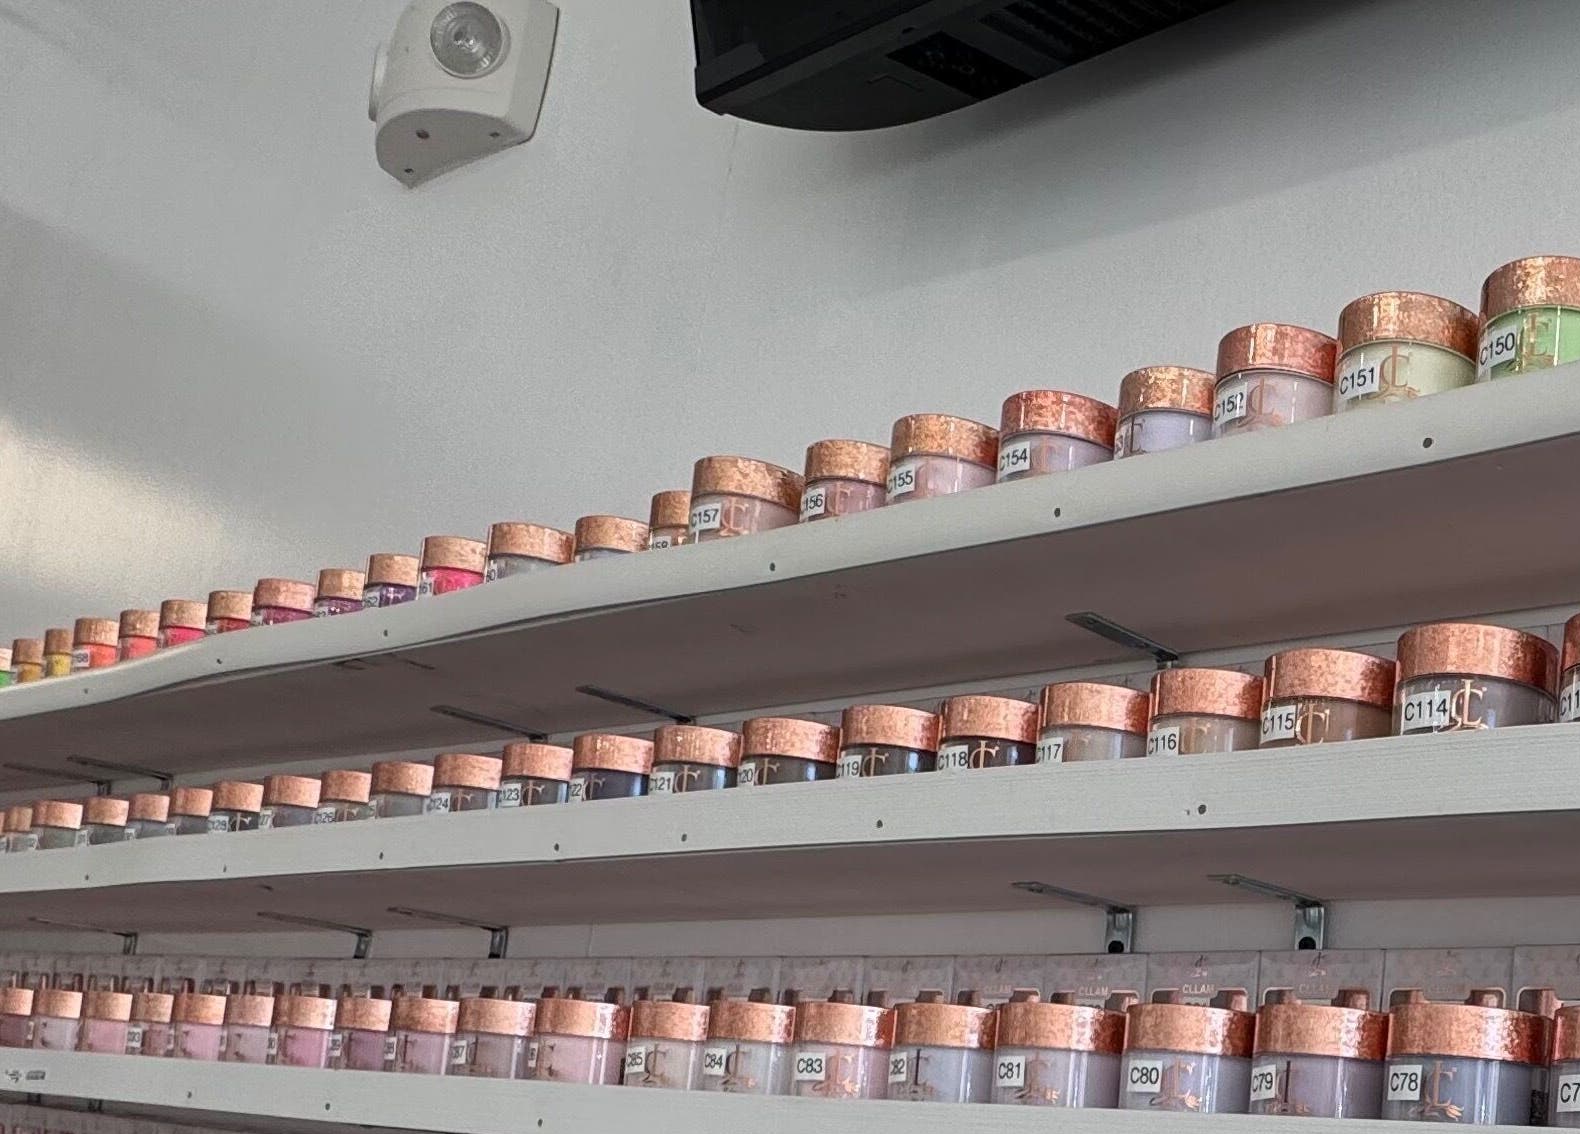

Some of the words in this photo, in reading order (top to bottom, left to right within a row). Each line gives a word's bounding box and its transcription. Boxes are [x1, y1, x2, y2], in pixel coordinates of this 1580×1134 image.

[1479, 332, 1516, 365] C150
[1339, 367, 1376, 396] C151
[1000, 447, 1029, 472] C154
[887, 470, 914, 494] C155
[691, 508, 720, 527] C157
[1262, 711, 1295, 733] C115
[1404, 701, 1449, 724] C114
[1148, 733, 1178, 755] C116
[938, 749, 968, 768] C118
[796, 1058, 823, 1075] C83
[998, 1062, 1022, 1080] C81
[1130, 1066, 1160, 1085] C80
[1251, 1073, 1273, 1094] C79
[1390, 1073, 1419, 1092] C78
